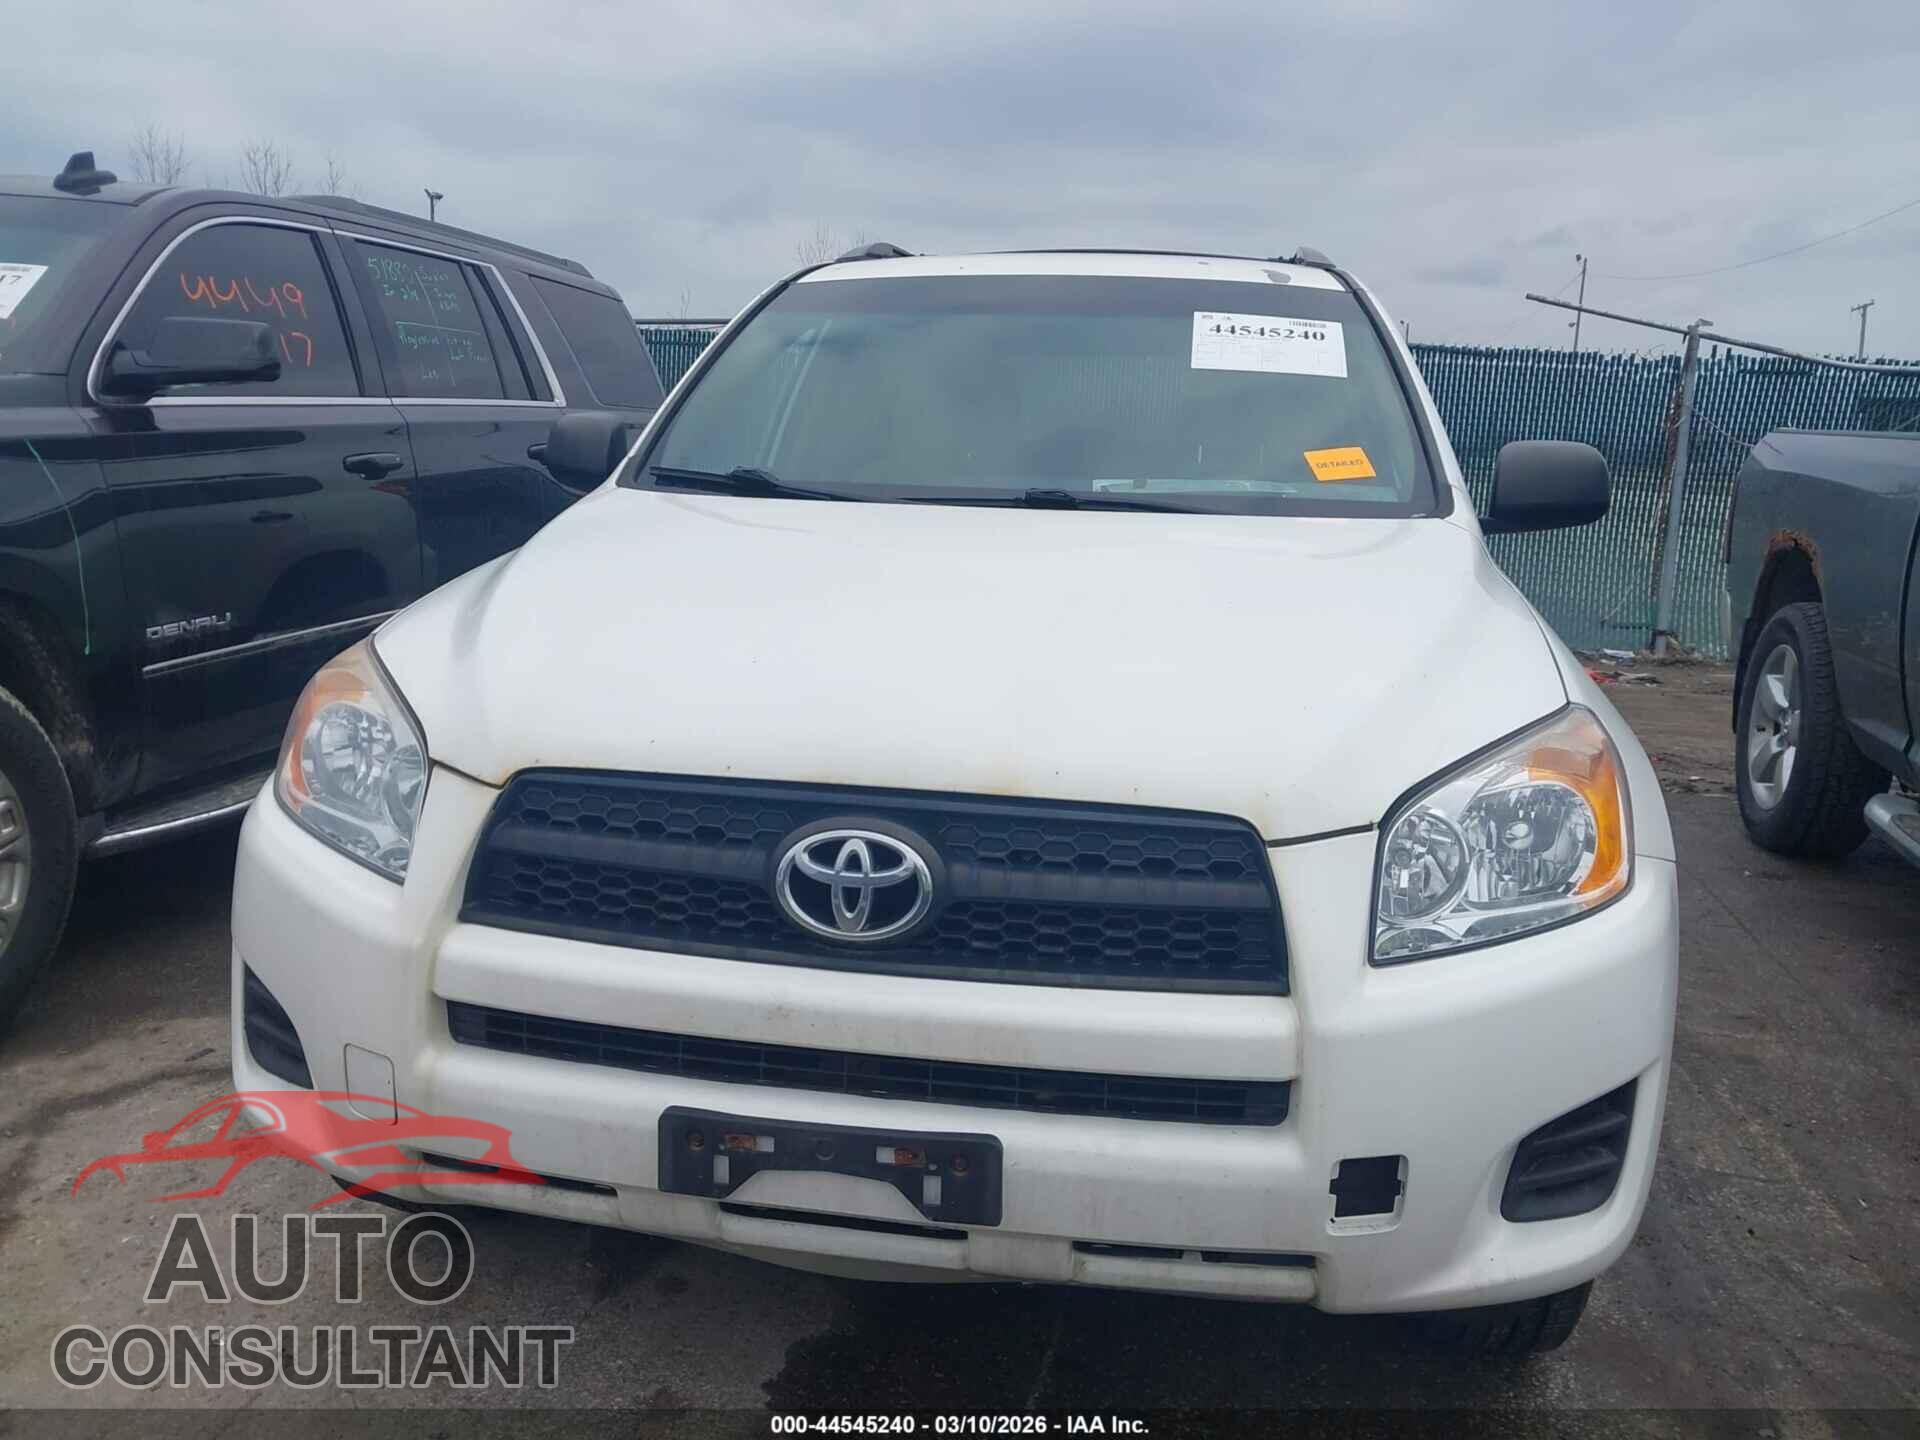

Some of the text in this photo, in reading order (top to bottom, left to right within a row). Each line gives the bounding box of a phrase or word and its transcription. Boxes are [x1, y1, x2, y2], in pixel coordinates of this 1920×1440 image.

[1208, 323, 1326, 341] 44545240
[1315, 458, 1365, 468] DETAILED
[145, 612, 232, 639] DENALI
